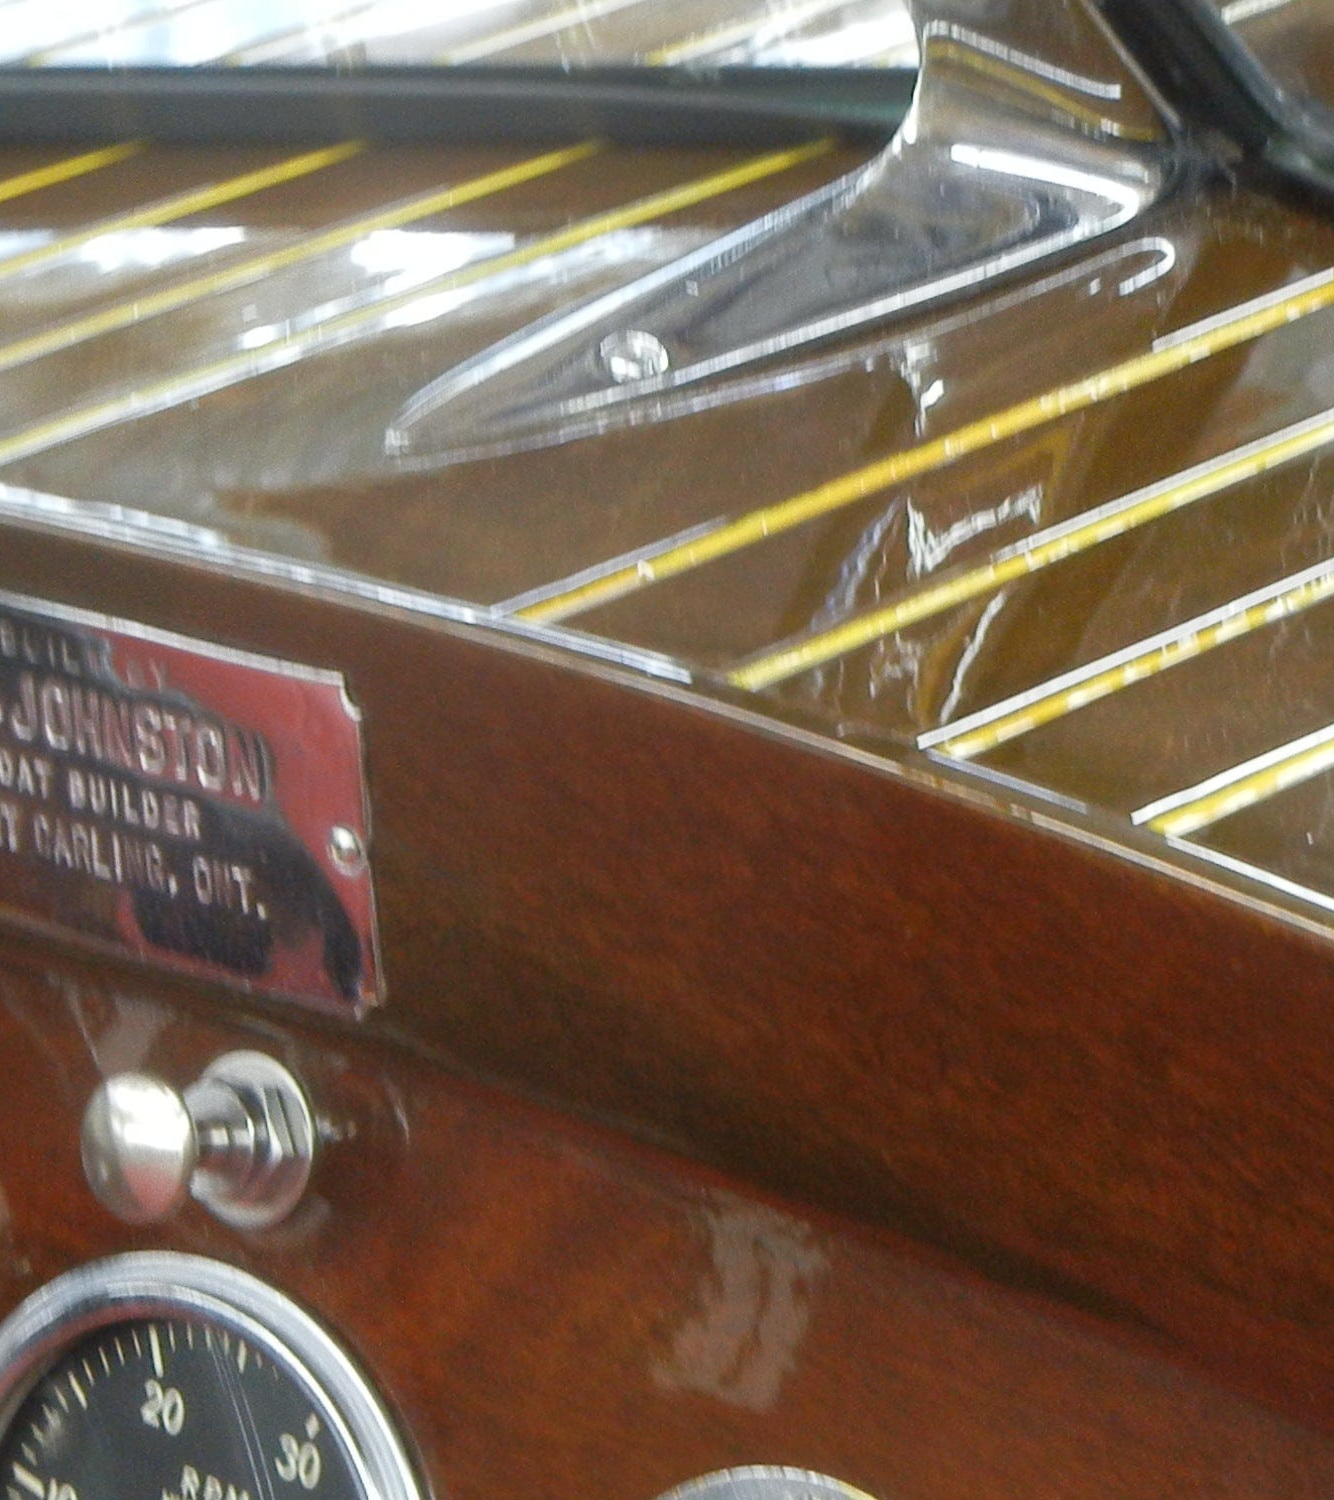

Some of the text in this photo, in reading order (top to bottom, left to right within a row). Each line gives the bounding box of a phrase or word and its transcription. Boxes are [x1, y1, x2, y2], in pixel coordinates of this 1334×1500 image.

[69, 768, 201, 841] BUILDER
[140, 1379, 185, 1436] 20
[275, 1433, 321, 1490] 30
